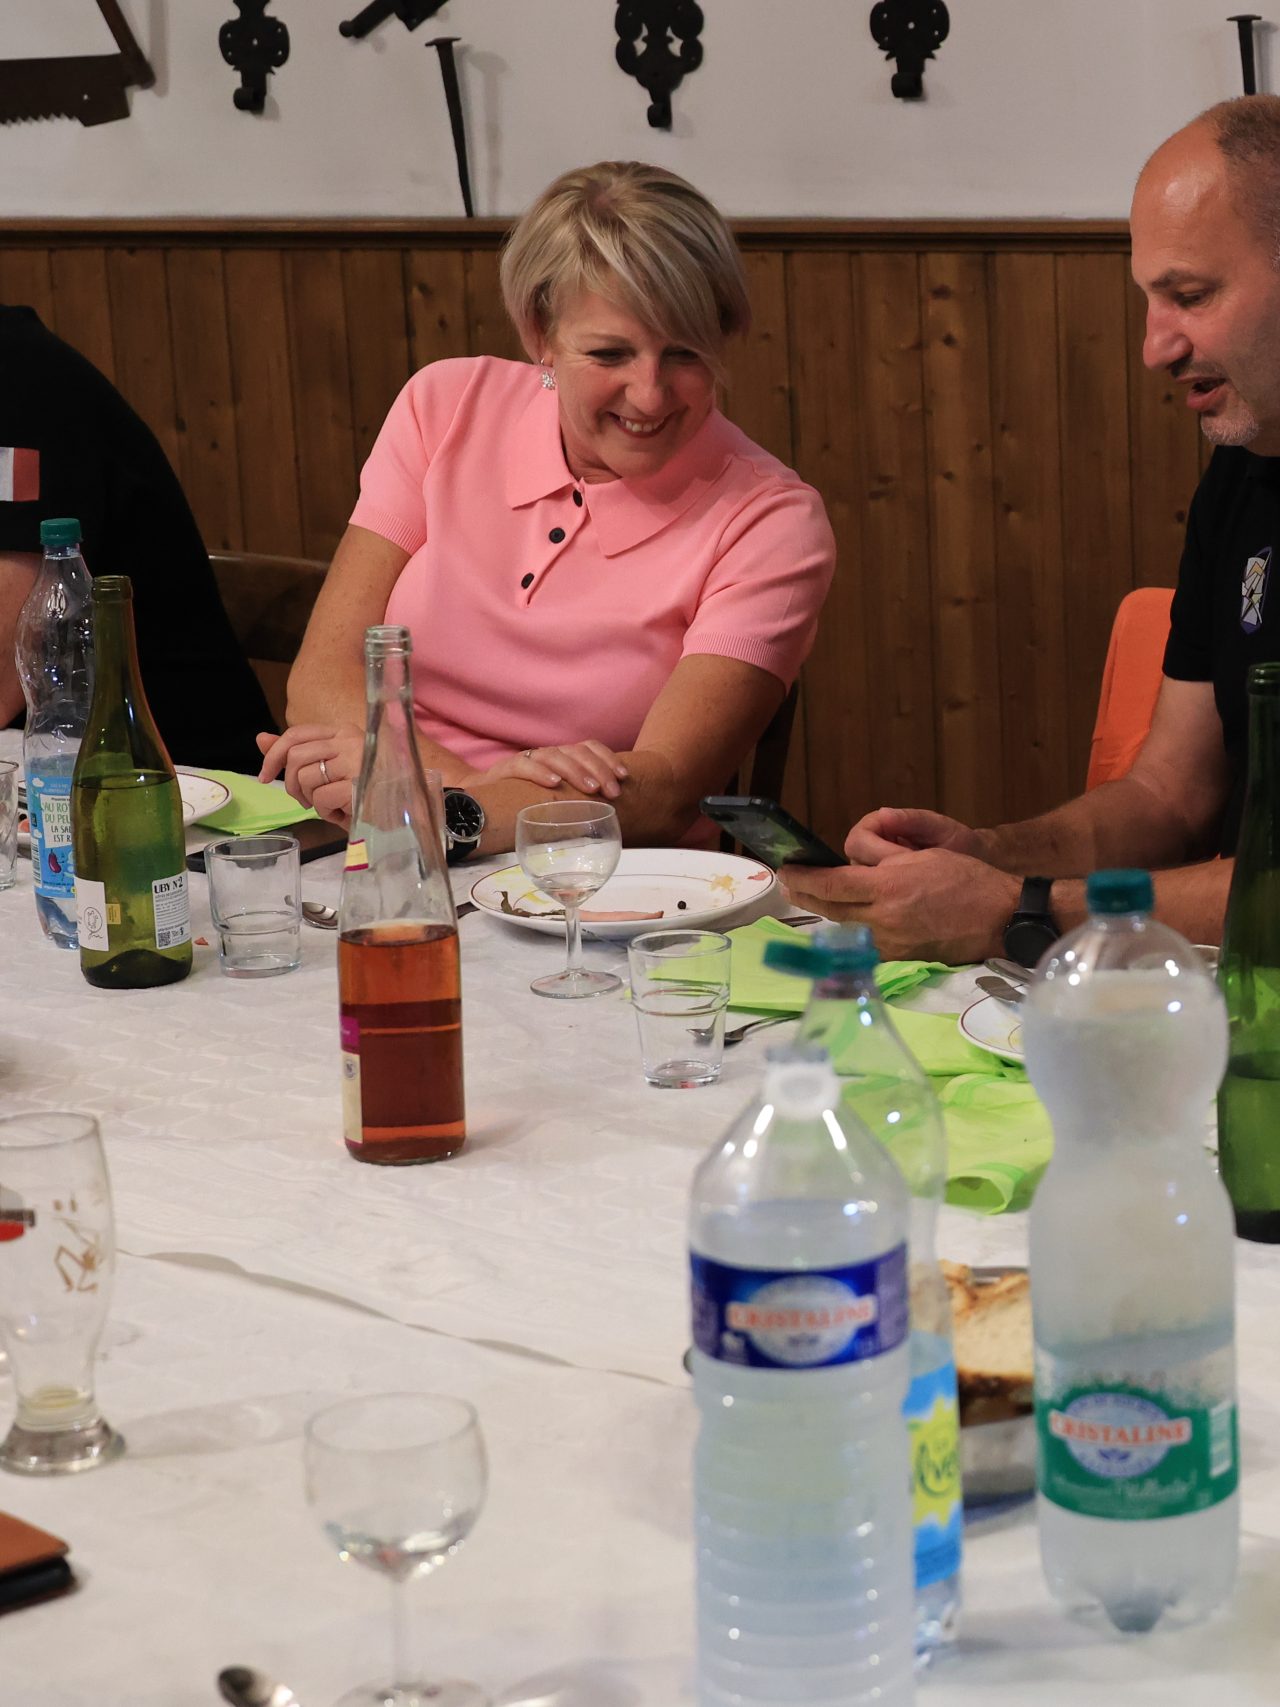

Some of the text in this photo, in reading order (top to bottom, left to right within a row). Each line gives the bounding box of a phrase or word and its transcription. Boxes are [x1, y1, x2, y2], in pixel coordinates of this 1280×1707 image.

[51, 825, 59, 833] LA
[154, 883, 170, 894] UBY
[1051, 1413, 1187, 1443] CRISTALINE
